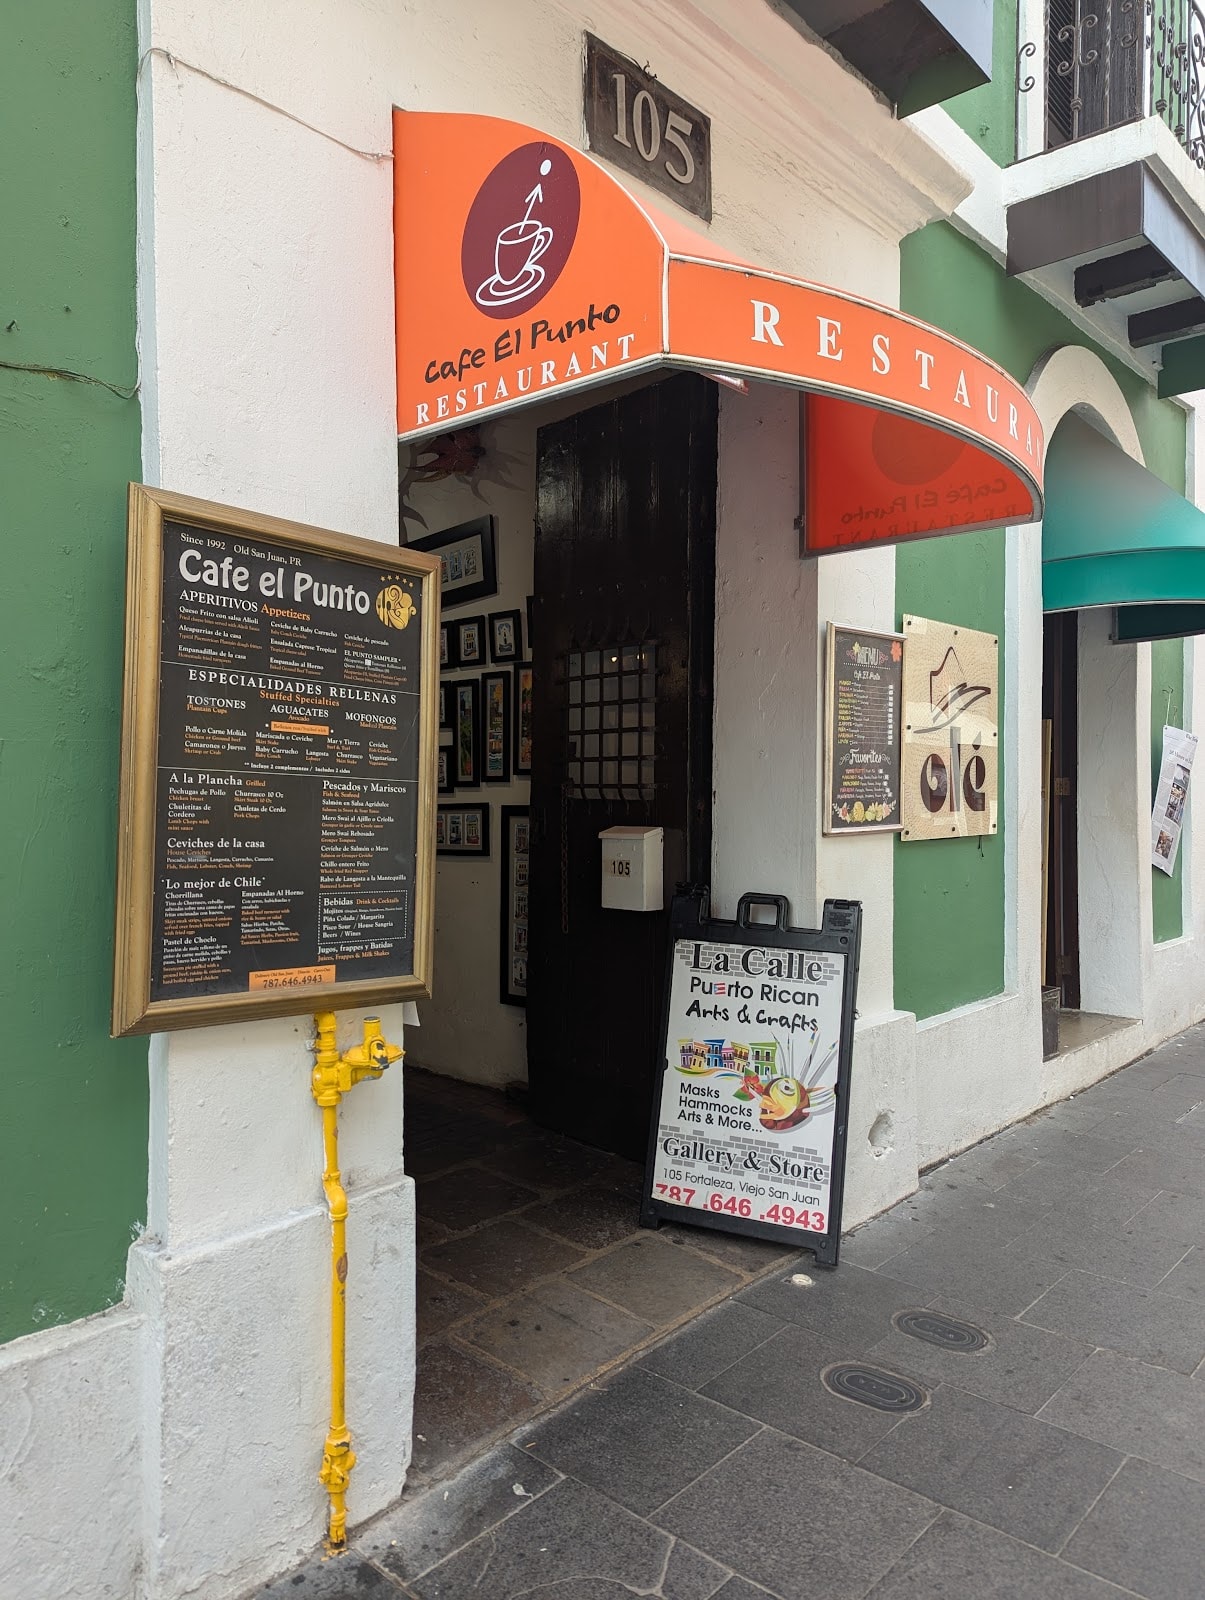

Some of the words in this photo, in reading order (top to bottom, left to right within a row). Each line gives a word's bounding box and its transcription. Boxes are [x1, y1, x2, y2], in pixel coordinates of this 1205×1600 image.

[612, 73, 695, 185] 105
[424, 346, 486, 384] Cafe
[494, 329, 522, 362] El
[530, 303, 621, 350] Punto
[415, 333, 636, 426] RESTAURANT
[180, 532, 204, 546] Since
[206, 538, 226, 551] 1992
[233, 544, 249, 556] Old
[251, 548, 266, 559] San
[267, 552, 288, 565] Juan,
[289, 556, 302, 567] PR
[179, 549, 250, 592] Cafe
[259, 567, 285, 599] el
[293, 571, 370, 615] Punto
[179, 589, 259, 613] APERITIVOS
[260, 603, 311, 622] Appetizers
[179, 605, 198, 615] Queso
[199, 609, 215, 618] Frito
[178, 624, 214, 635] Alcapurrias
[270, 620, 291, 630] Ceviche
[178, 645, 218, 656] Empanadillas
[352, 650, 373, 660] PUNTO
[188, 669, 322, 695] ESPECIALIDADES
[329, 686, 397, 705] RELLENAS
[260, 689, 293, 702] Stuffed
[295, 694, 340, 707] Specialties
[186, 704, 212, 713] Plantain
[212, 705, 228, 714] Cups
[186, 695, 247, 710] TOSTONES
[270, 704, 329, 718] AGUACATES
[345, 711, 397, 725] MOFONGOS
[288, 714, 310, 722] Avocado
[185, 725, 201, 733] Pollo
[207, 727, 226, 736] Carne
[226, 728, 247, 737] Molida
[255, 731, 285, 740] Mariscada
[291, 734, 314, 743] Ceviche
[184, 740, 220, 749] Camarones
[227, 744, 247, 752] Jueyes
[327, 737, 338, 745] Mar
[344, 738, 360, 746] Tierra
[368, 741, 389, 749] Ceviche
[255, 745, 271, 754] Baby
[271, 746, 299, 755] Carrucho
[305, 749, 329, 758] Langosta
[336, 751, 363, 760] Churrasco
[368, 754, 398, 762] Vegetariano
[849, 747, 882, 765] Favorites
[169, 772, 179, 783] A
[183, 772, 194, 784] la
[197, 773, 243, 786] Plancha
[245, 779, 266, 787] Grilled
[169, 787, 199, 796] Pechugas
[199, 788, 208, 796] de
[209, 788, 227, 797] Pollo
[322, 780, 361, 791] Pescados
[363, 784, 368, 793] y
[370, 782, 407, 793] Mariscos
[234, 789, 266, 798] Churrasco
[168, 803, 202, 811] Chuletitas
[203, 803, 212, 811] de
[233, 805, 260, 813] Chuletas
[260, 805, 268, 813] de
[268, 805, 287, 813] Cerdo
[167, 837, 214, 848] Ceviches
[217, 837, 230, 848] de
[232, 837, 243, 848] la
[244, 840, 265, 848] casa
[612, 860, 630, 876] 105
[165, 878, 180, 890] Lo
[183, 878, 216, 890] mejor
[218, 877, 231, 888] de
[234, 876, 262, 888] Chile
[165, 891, 204, 900] Chorrillana
[241, 890, 275, 898] Empanadas
[323, 897, 354, 907] Bebidas
[163, 938, 183, 946] Pastel
[183, 937, 192, 945] de
[193, 936, 217, 944] Choclo
[339, 944, 364, 953] frappes
[370, 941, 394, 950] Batidas
[690, 943, 731, 972] La
[741, 947, 824, 984] Calle
[263, 974, 323, 989] 787.646.4943
[689, 976, 754, 1000] Puerto
[760, 984, 820, 1007] Rican
[685, 999, 730, 1022] Arts
[737, 1004, 751, 1025] &
[755, 1008, 819, 1034] Crafts
[680, 1082, 721, 1099] Masks
[678, 1097, 754, 1118] Hammocks
[677, 1111, 703, 1125] Arts
[704, 1114, 715, 1126] &
[717, 1116, 764, 1134] More...
[662, 1136, 738, 1171] Gallery
[743, 1151, 762, 1172] &
[768, 1155, 826, 1182] Store
[663, 1167, 683, 1181] 105
[684, 1171, 737, 1191] Fortaleza,
[738, 1180, 766, 1198] Viejo
[767, 1186, 790, 1201] San
[791, 1190, 821, 1207] Juan
[655, 1183, 697, 1206] 787
[702, 1193, 752, 1217] .646
[759, 1203, 825, 1232] .4943
